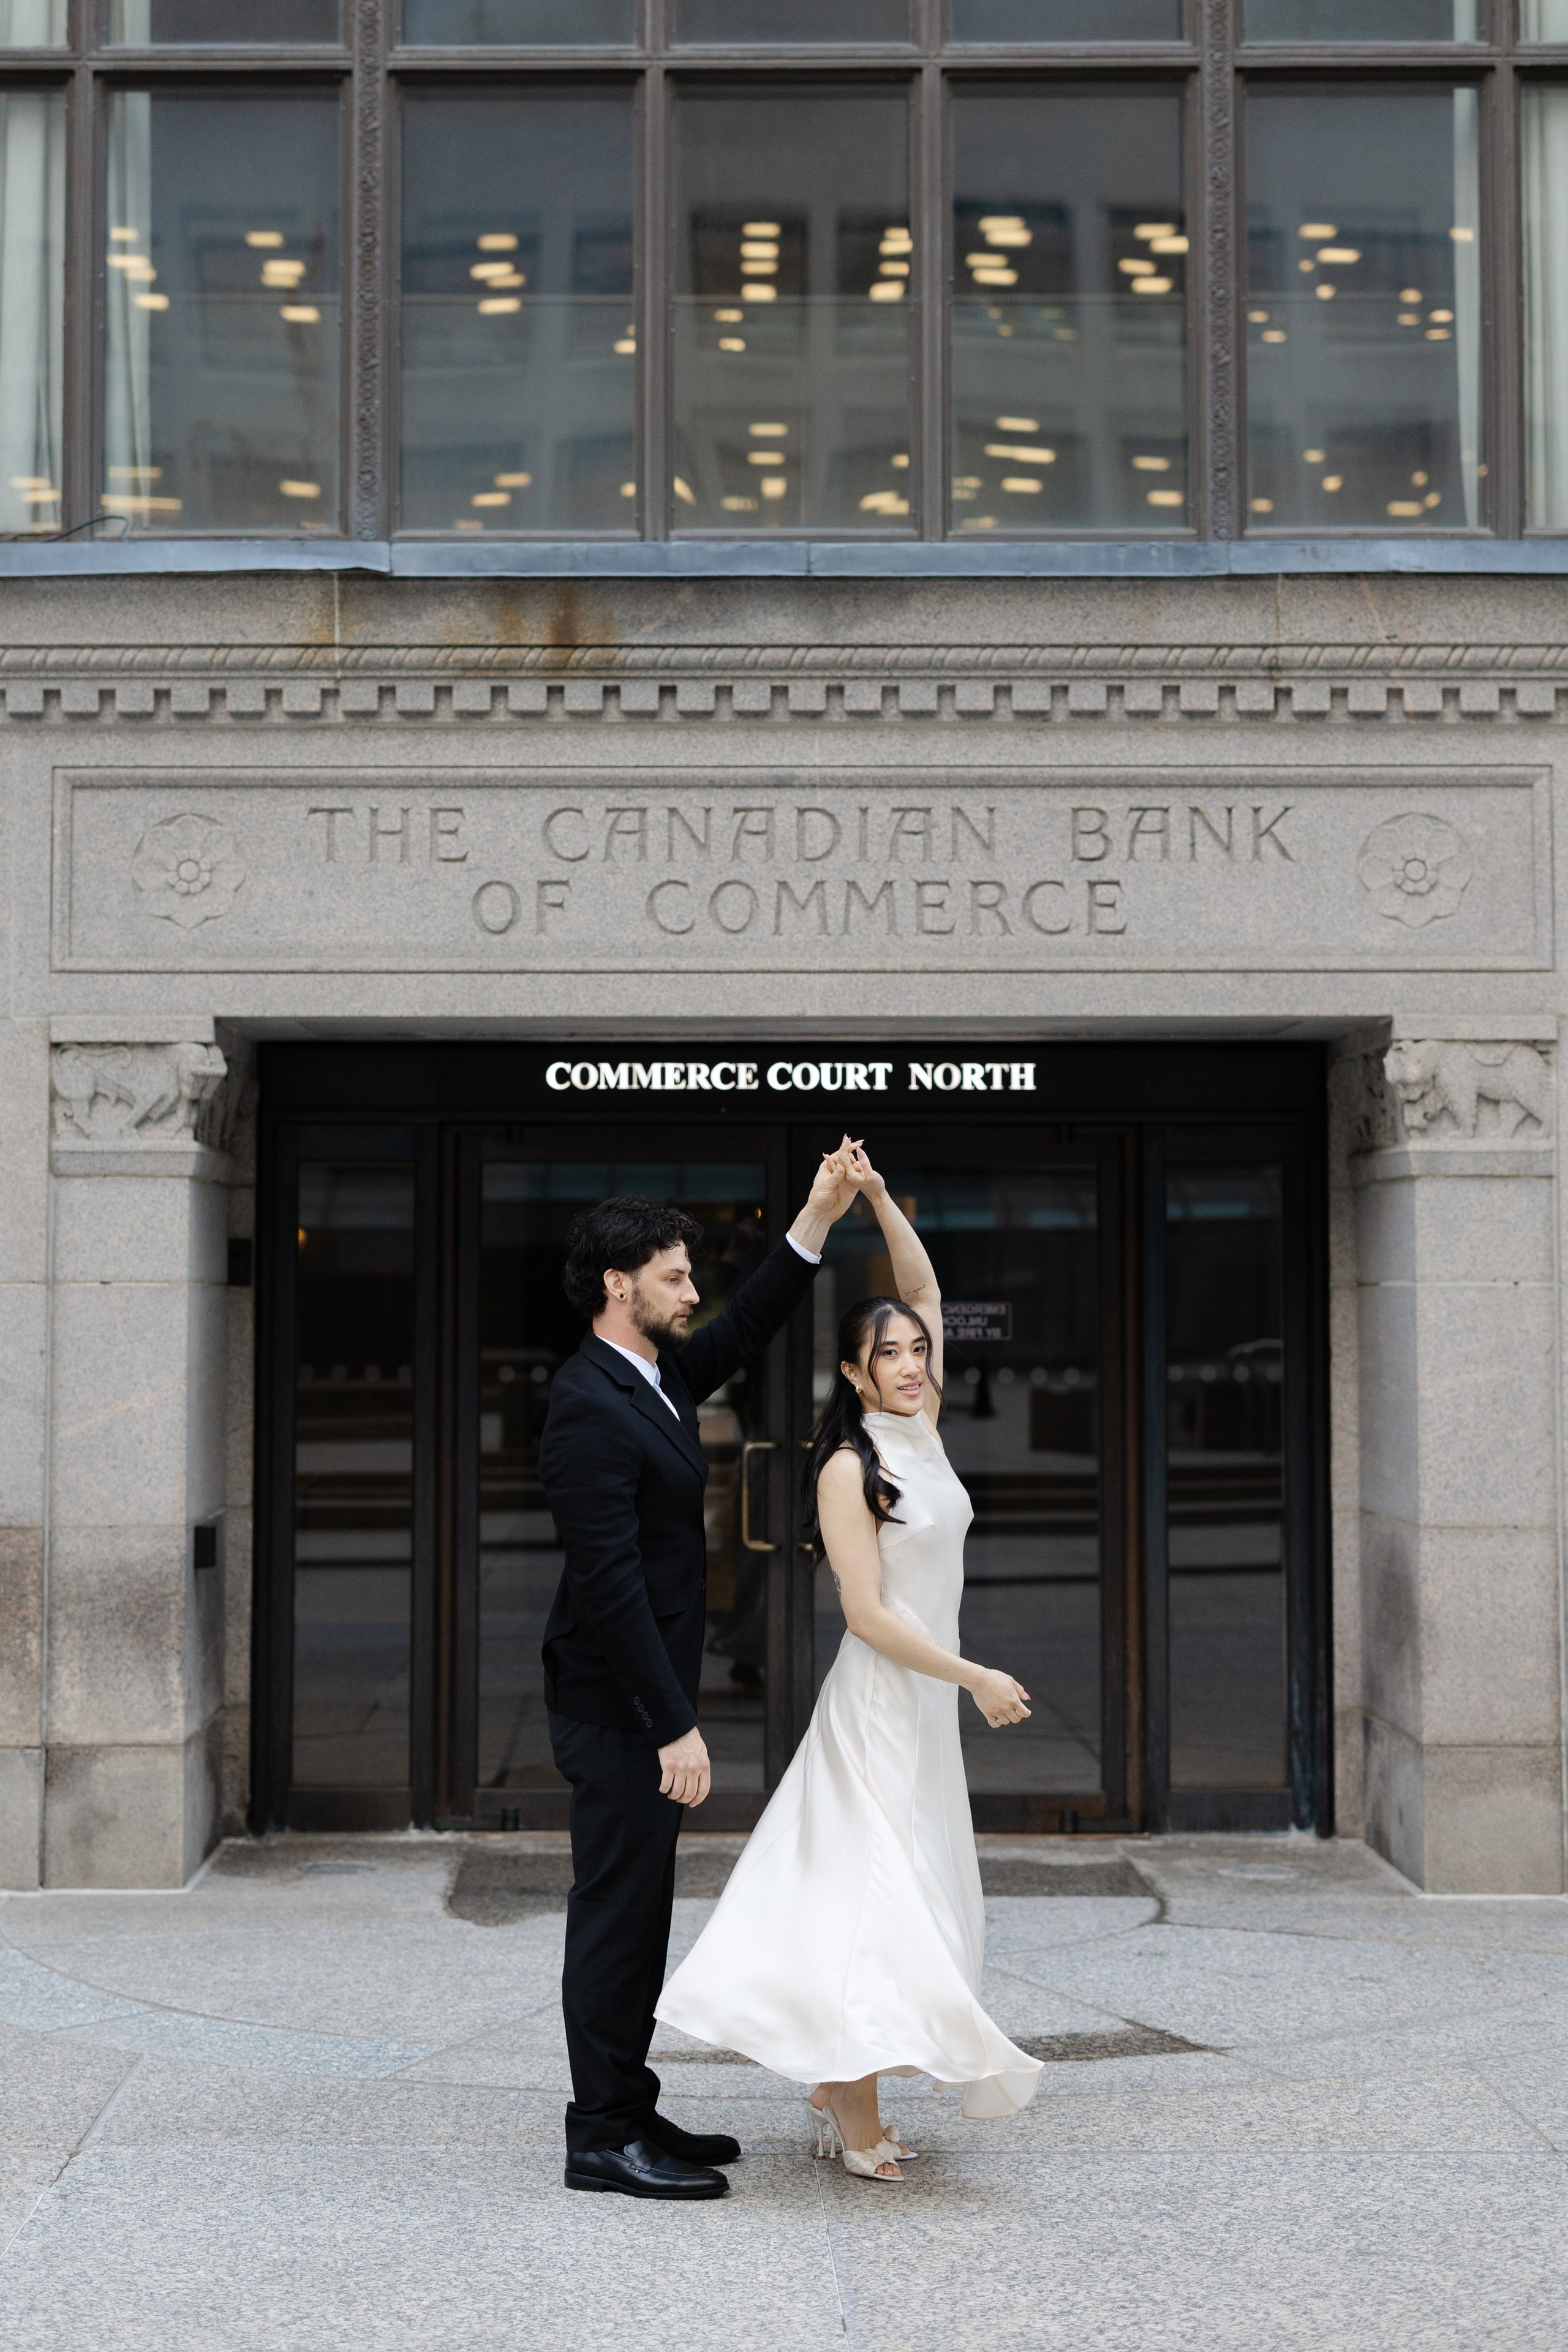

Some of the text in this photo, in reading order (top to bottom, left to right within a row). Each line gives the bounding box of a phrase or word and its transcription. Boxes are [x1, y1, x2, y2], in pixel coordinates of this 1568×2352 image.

[307, 805, 1295, 864] THE CANADIAN BANK
[471, 878, 1128, 938] OF COMMERCE
[545, 1061, 1037, 1091] COMMERCE COURT NORTH
